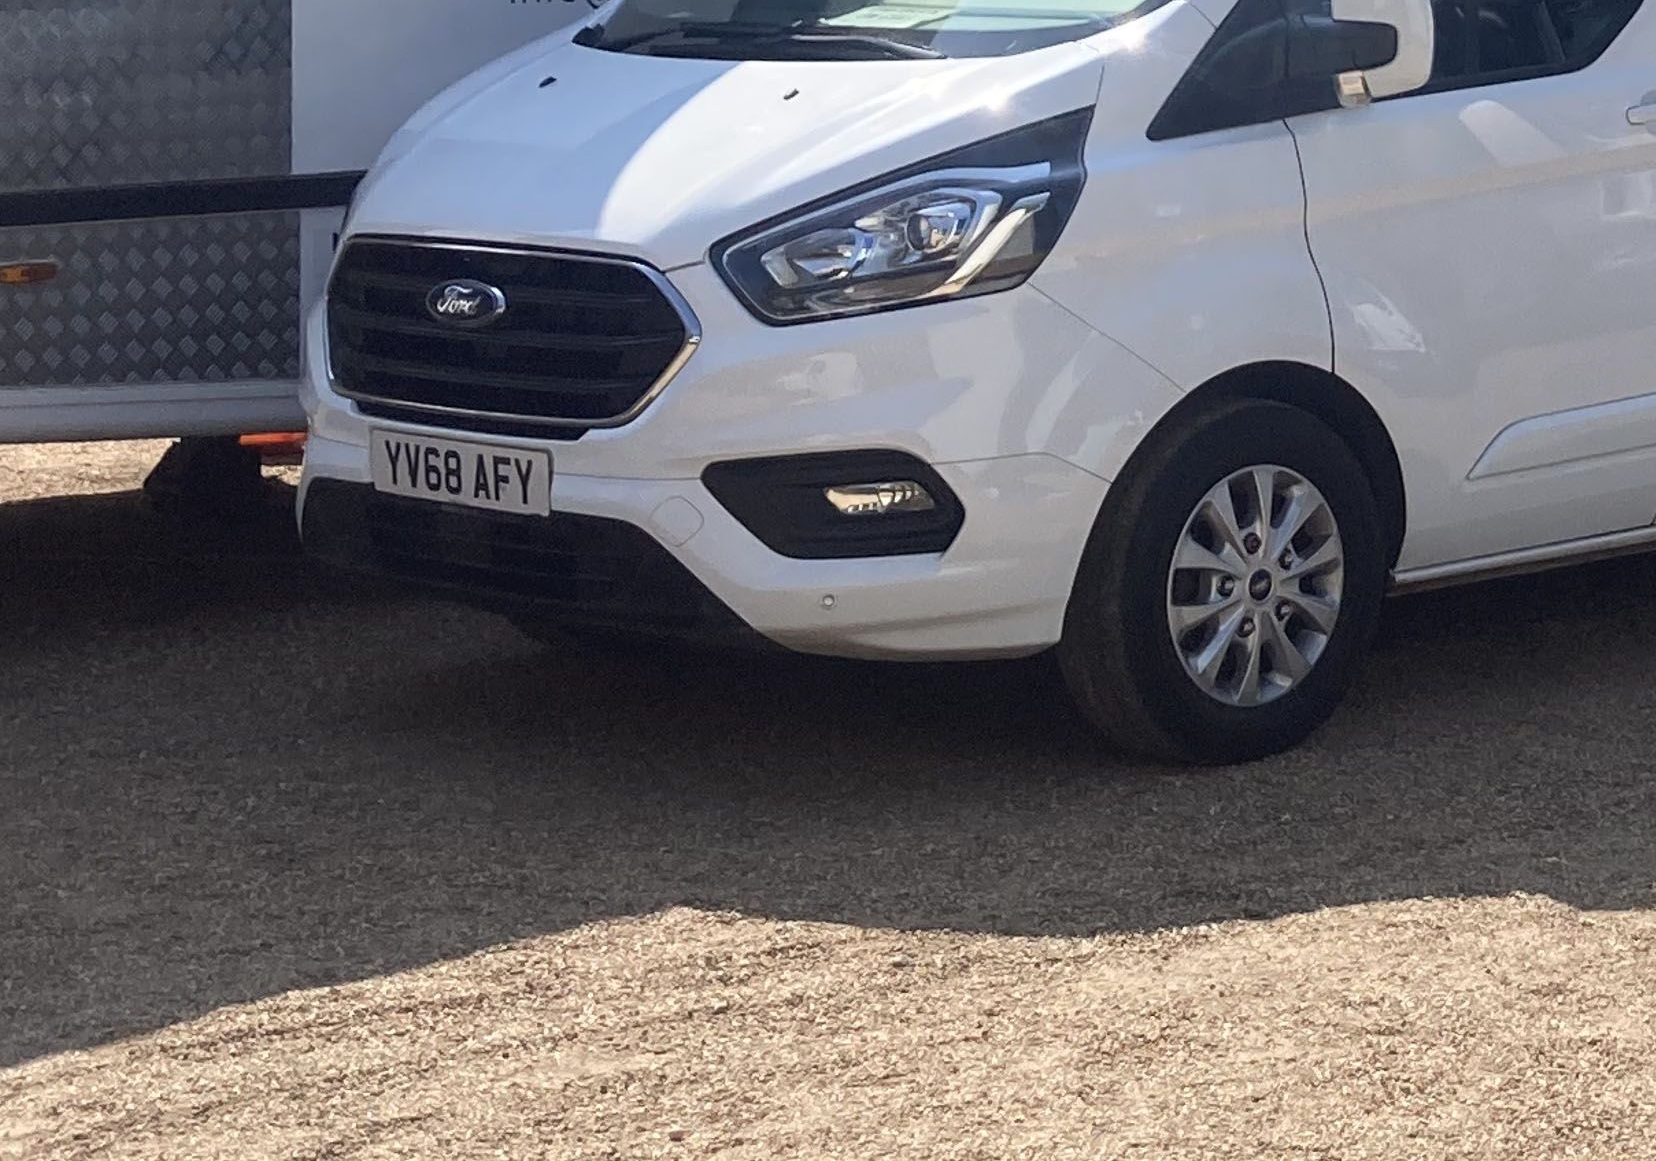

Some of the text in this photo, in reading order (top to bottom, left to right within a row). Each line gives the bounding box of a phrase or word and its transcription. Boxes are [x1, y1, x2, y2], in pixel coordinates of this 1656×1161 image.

[436, 285, 484, 316] Ford
[385, 440, 533, 505] YV68 AFY
